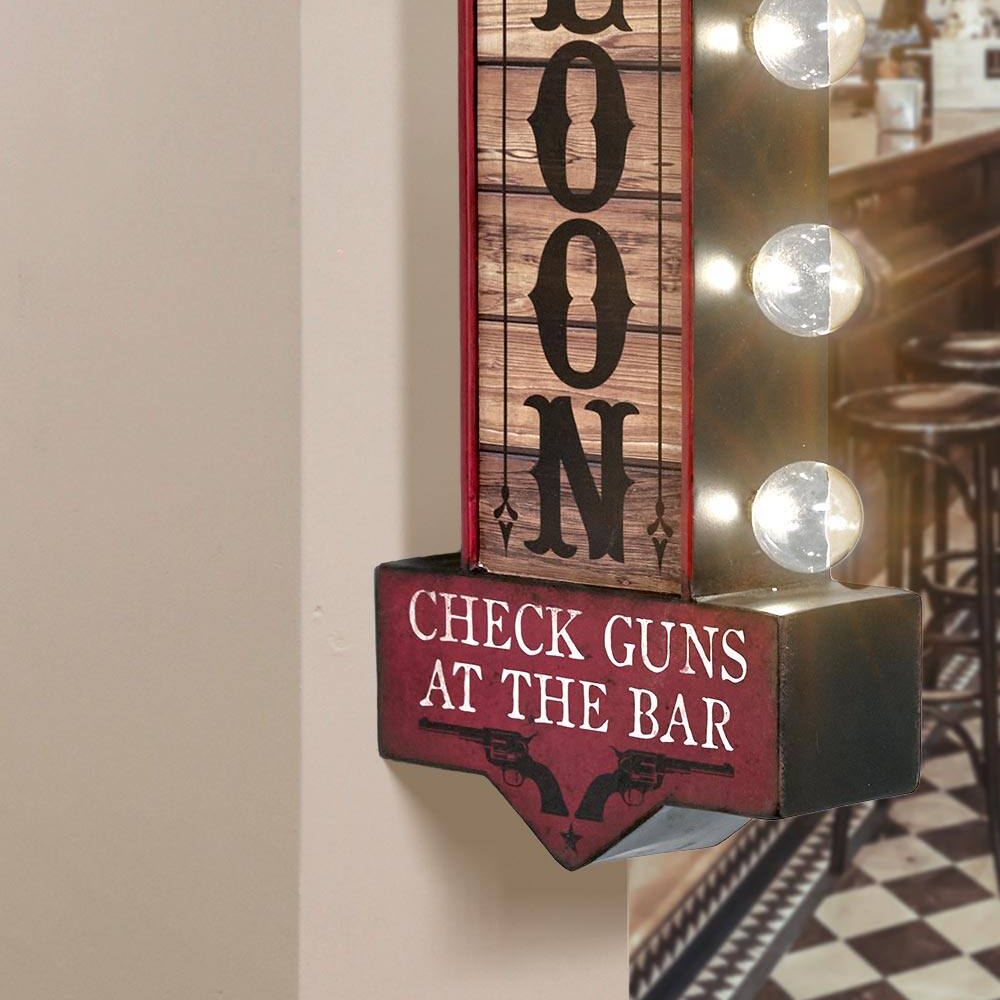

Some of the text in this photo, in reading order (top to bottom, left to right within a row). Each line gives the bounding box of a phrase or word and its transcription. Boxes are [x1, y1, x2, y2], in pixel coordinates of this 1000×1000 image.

[408, 589, 748, 684] CHECK GUNS
[419, 659, 735, 752] AT THE BAR
